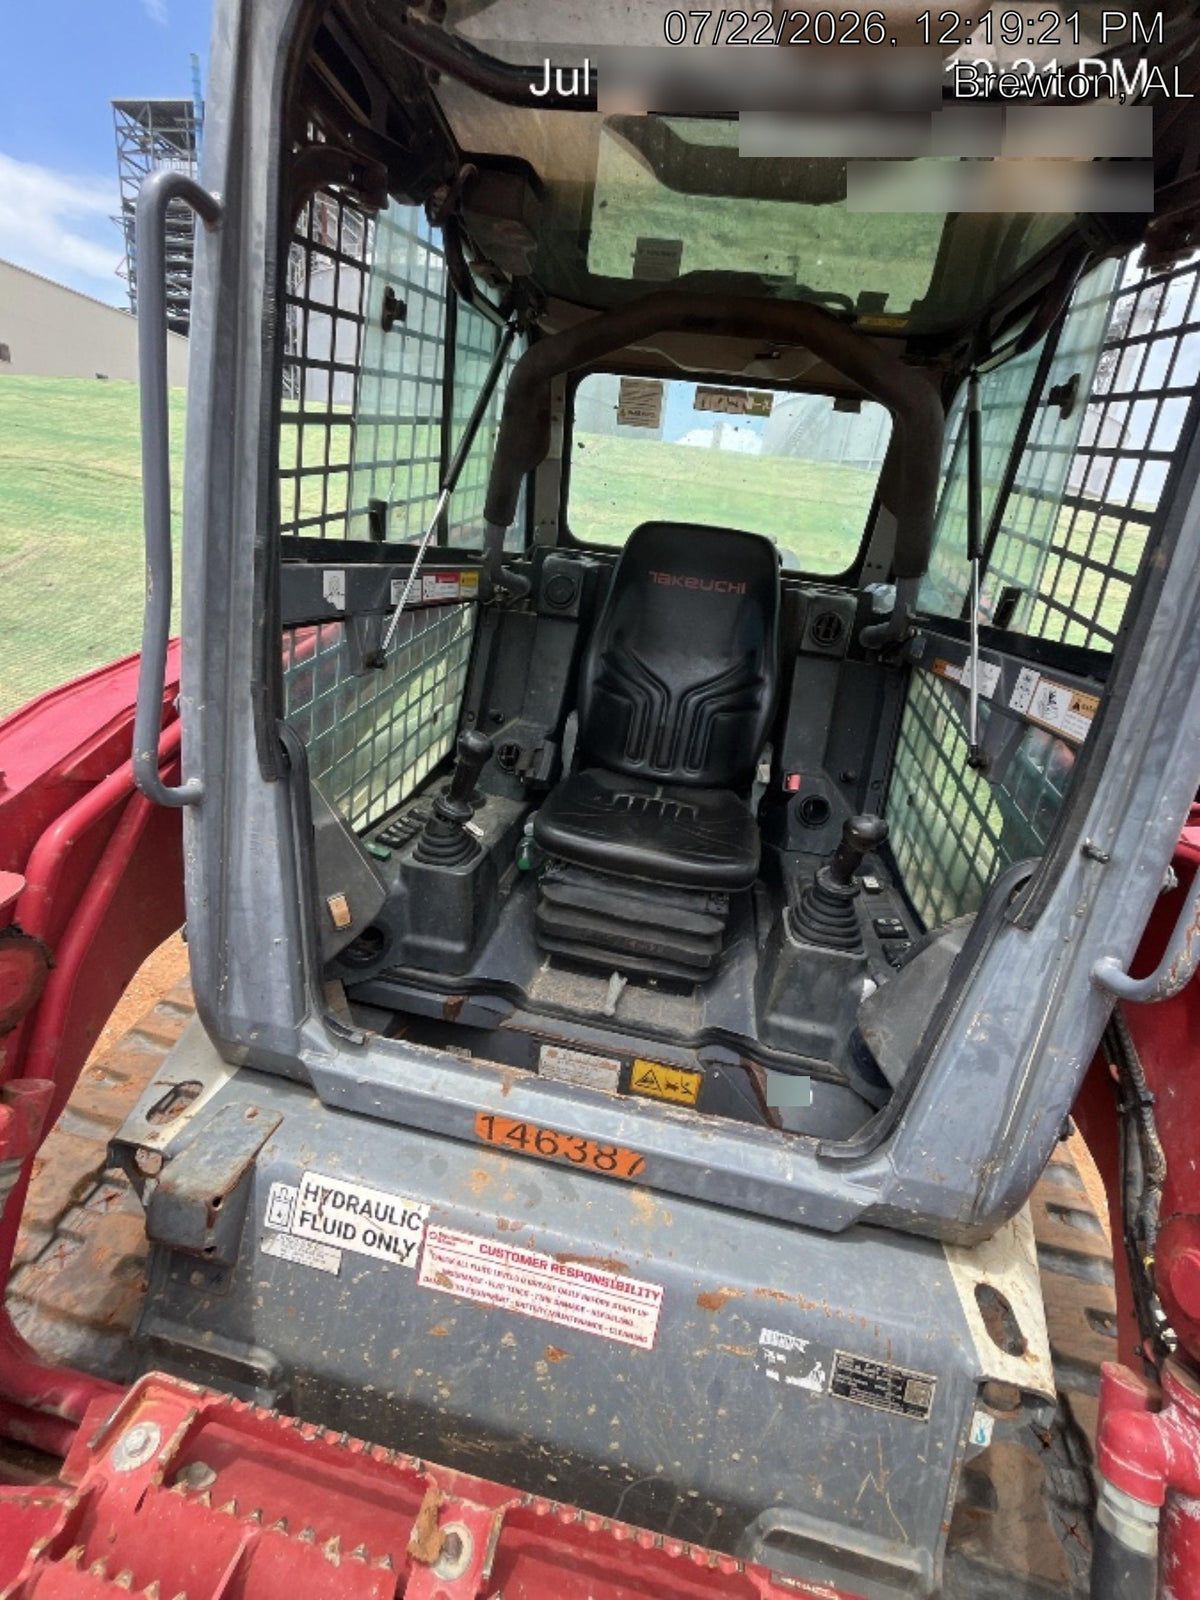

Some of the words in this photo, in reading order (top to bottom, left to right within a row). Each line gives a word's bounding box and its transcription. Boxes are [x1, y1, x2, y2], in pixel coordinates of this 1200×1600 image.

[303, 1182, 422, 1231] HYDRAULIC
[300, 1210, 357, 1240] FLUID
[362, 1229, 416, 1258] ONLY
[478, 1243, 548, 1270] CUSTOMER
[549, 1262, 660, 1301] RESPONSIBILITY
